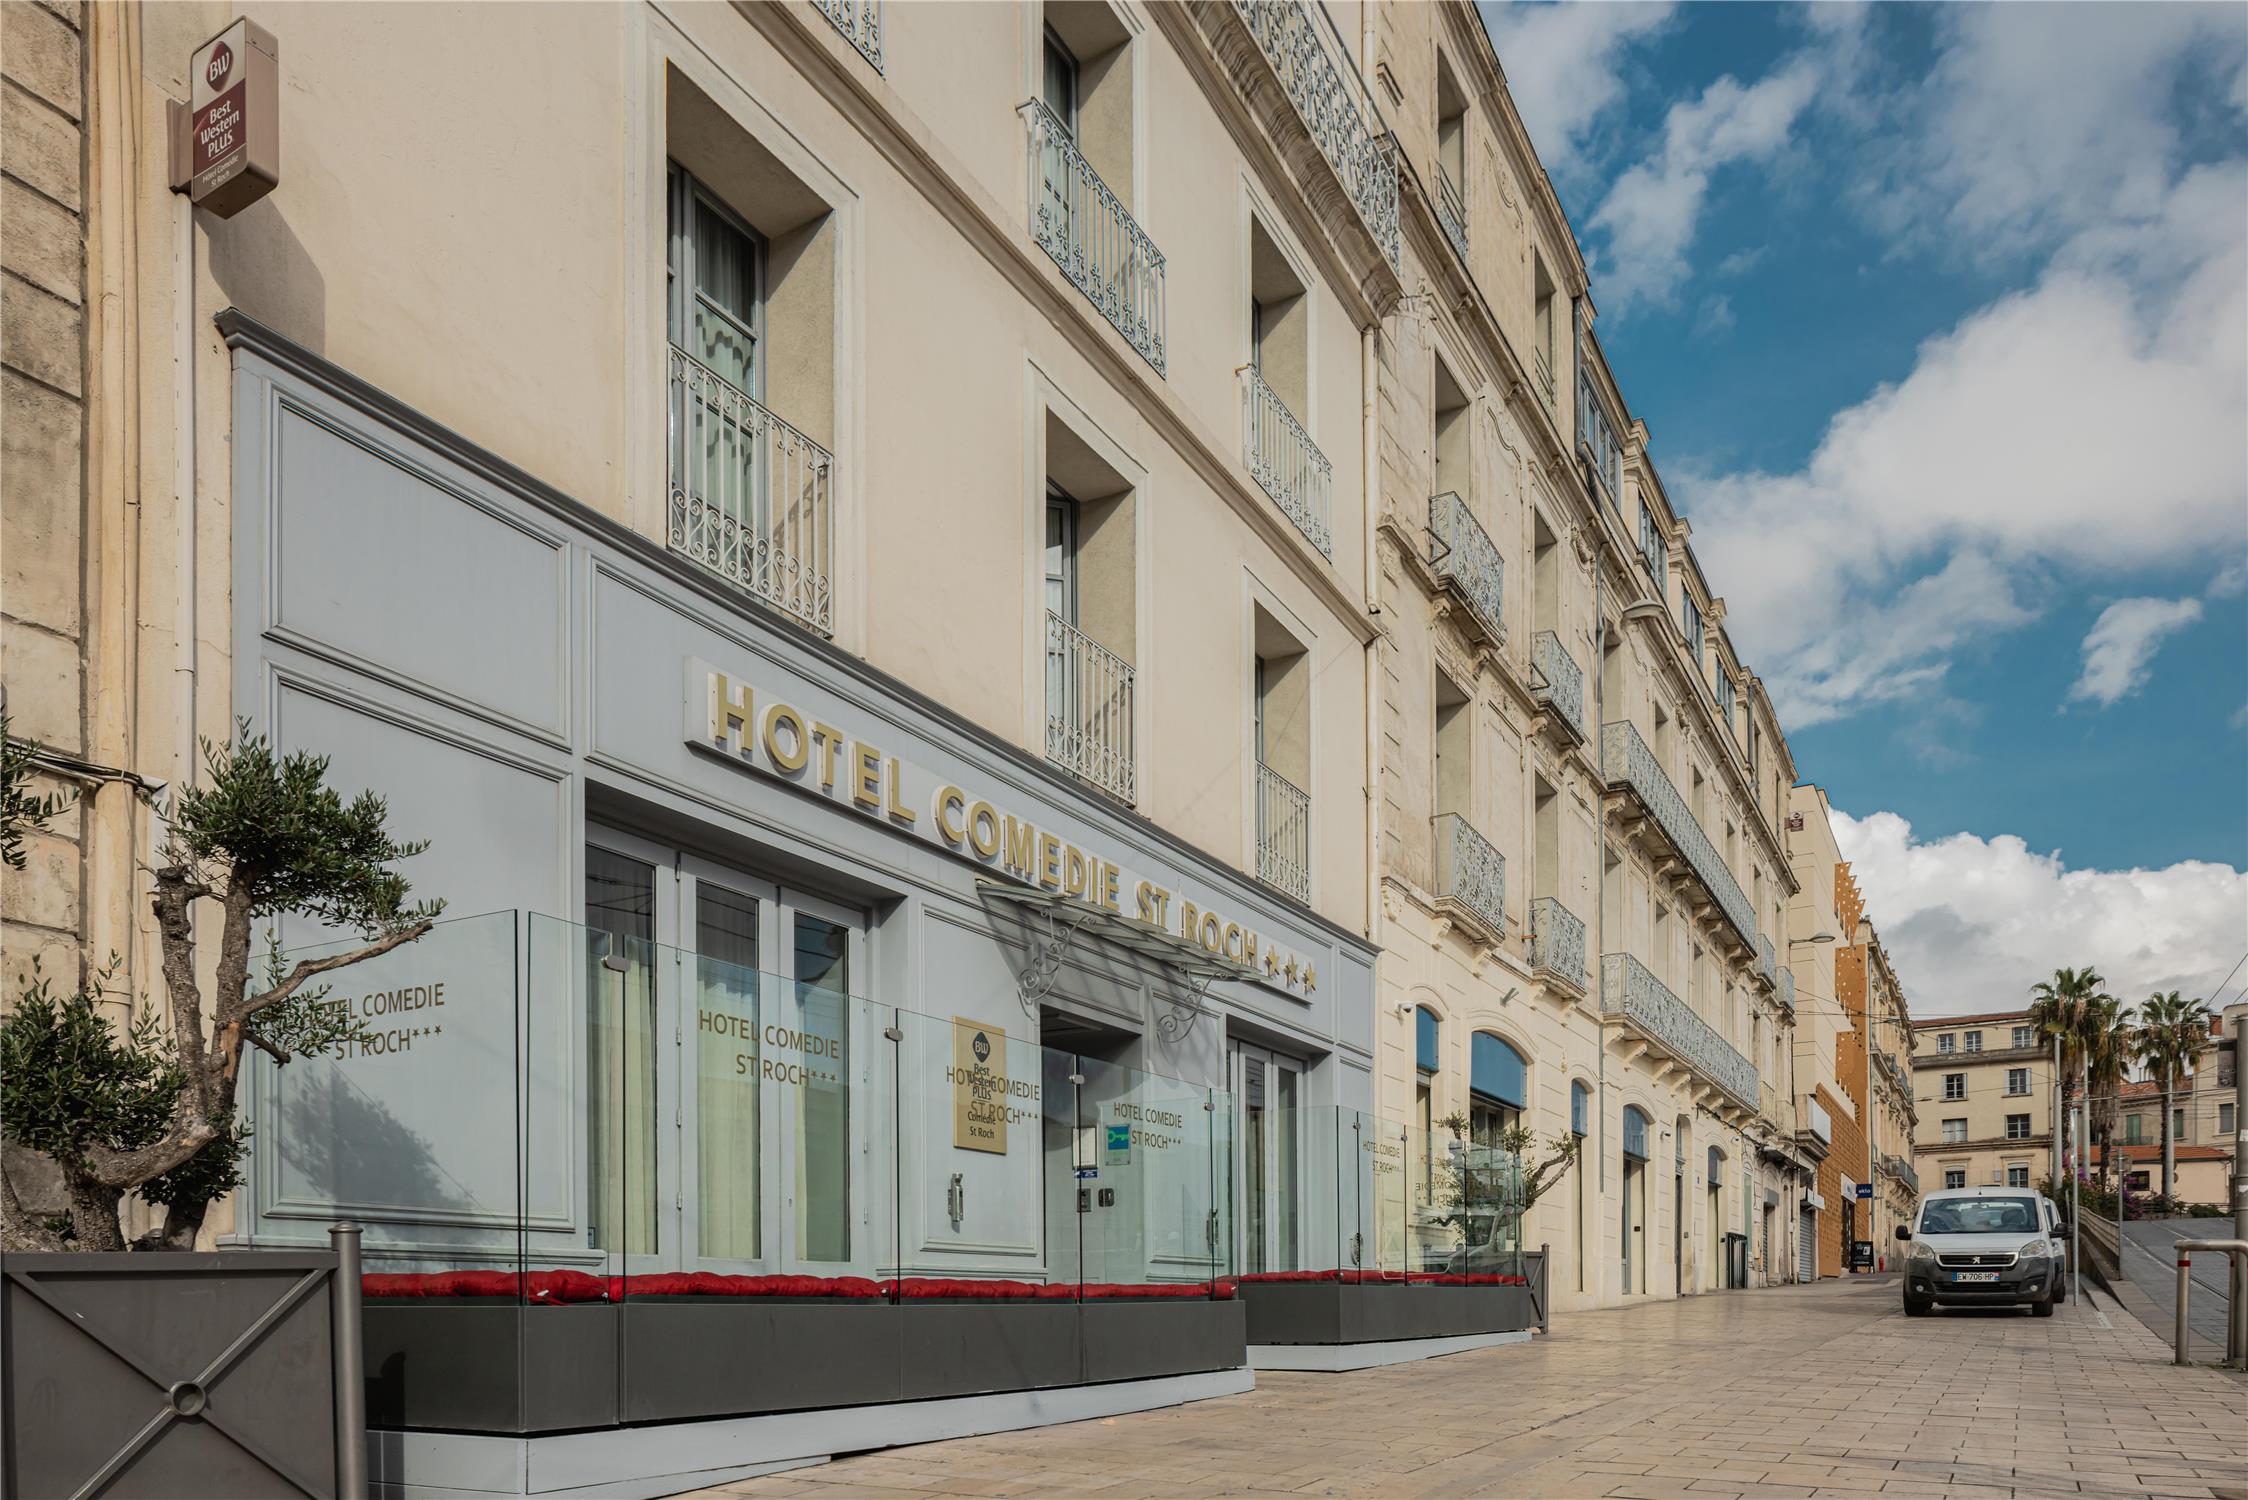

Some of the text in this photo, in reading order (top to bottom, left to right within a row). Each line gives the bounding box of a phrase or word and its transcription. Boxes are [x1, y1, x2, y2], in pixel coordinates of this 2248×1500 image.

[209, 52, 230, 82] BW
[210, 100, 231, 124] Best
[201, 110, 240, 145] Western
[208, 129, 233, 158] PLUS
[708, 672, 1258, 968] HOTEL COMEDIE ST ROCH
[362, 983, 445, 1017] COMEDIE
[699, 1009, 840, 1060] HOTEL COMEDIE
[974, 1041, 989, 1054] BW
[736, 1054, 758, 1077] ST
[974, 1063, 990, 1077] Best
[990, 1075, 1040, 1101] COMEDIE
[970, 1100, 986, 1122] ST
[1113, 1102, 1183, 1129] HOTEL COMEDIE
[969, 1126, 995, 1139] St Roch
[1131, 1130, 1142, 1146] ST
[1362, 1140, 1379, 1154] HOTEL
